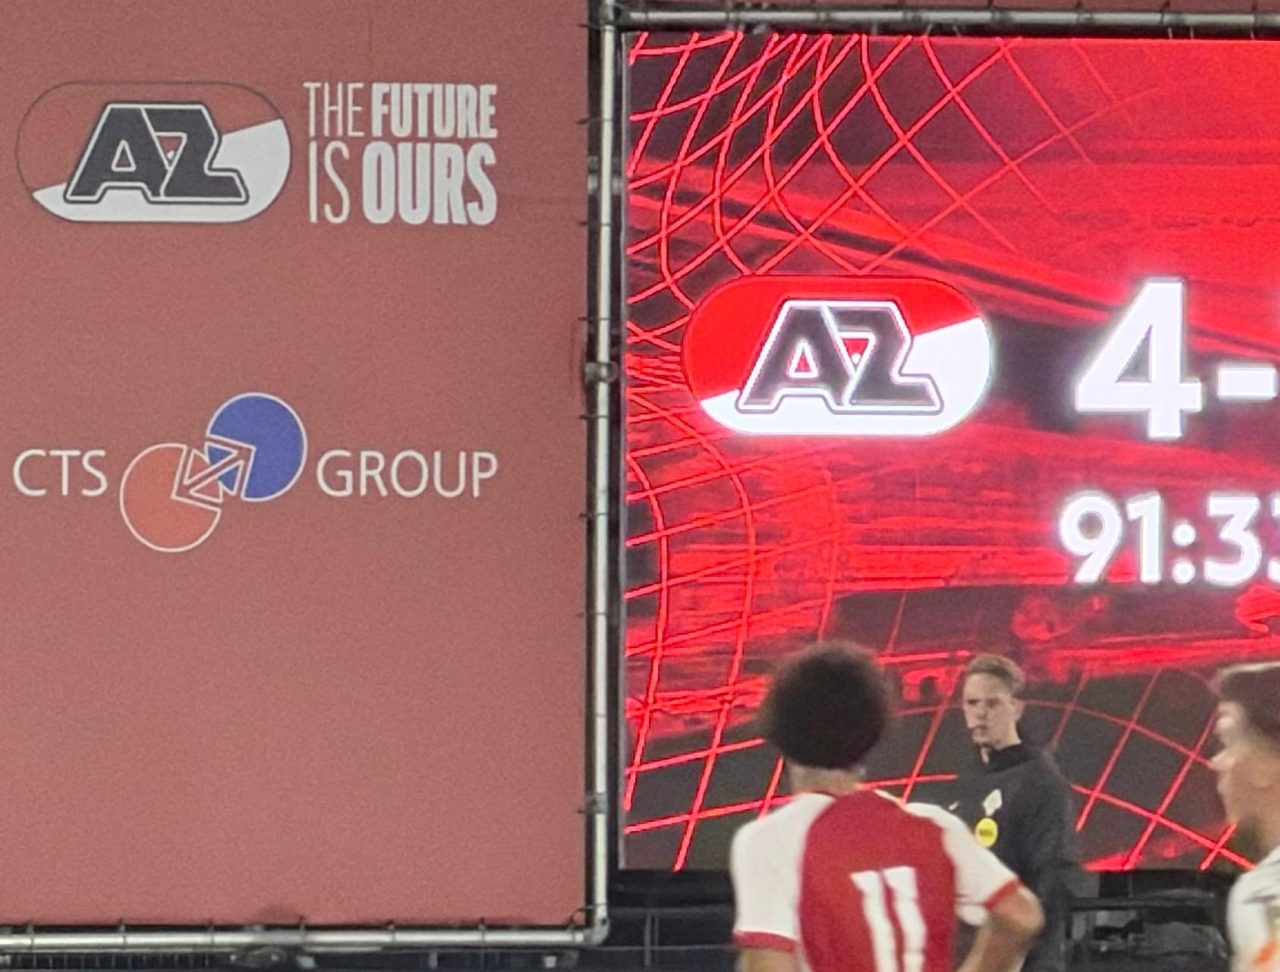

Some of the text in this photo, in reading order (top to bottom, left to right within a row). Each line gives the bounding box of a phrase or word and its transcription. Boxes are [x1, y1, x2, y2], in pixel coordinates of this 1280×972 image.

[303, 82, 497, 139] THE FUTURE
[309, 141, 498, 226] IS OURS
[13, 448, 499, 498] CTS GROUP
